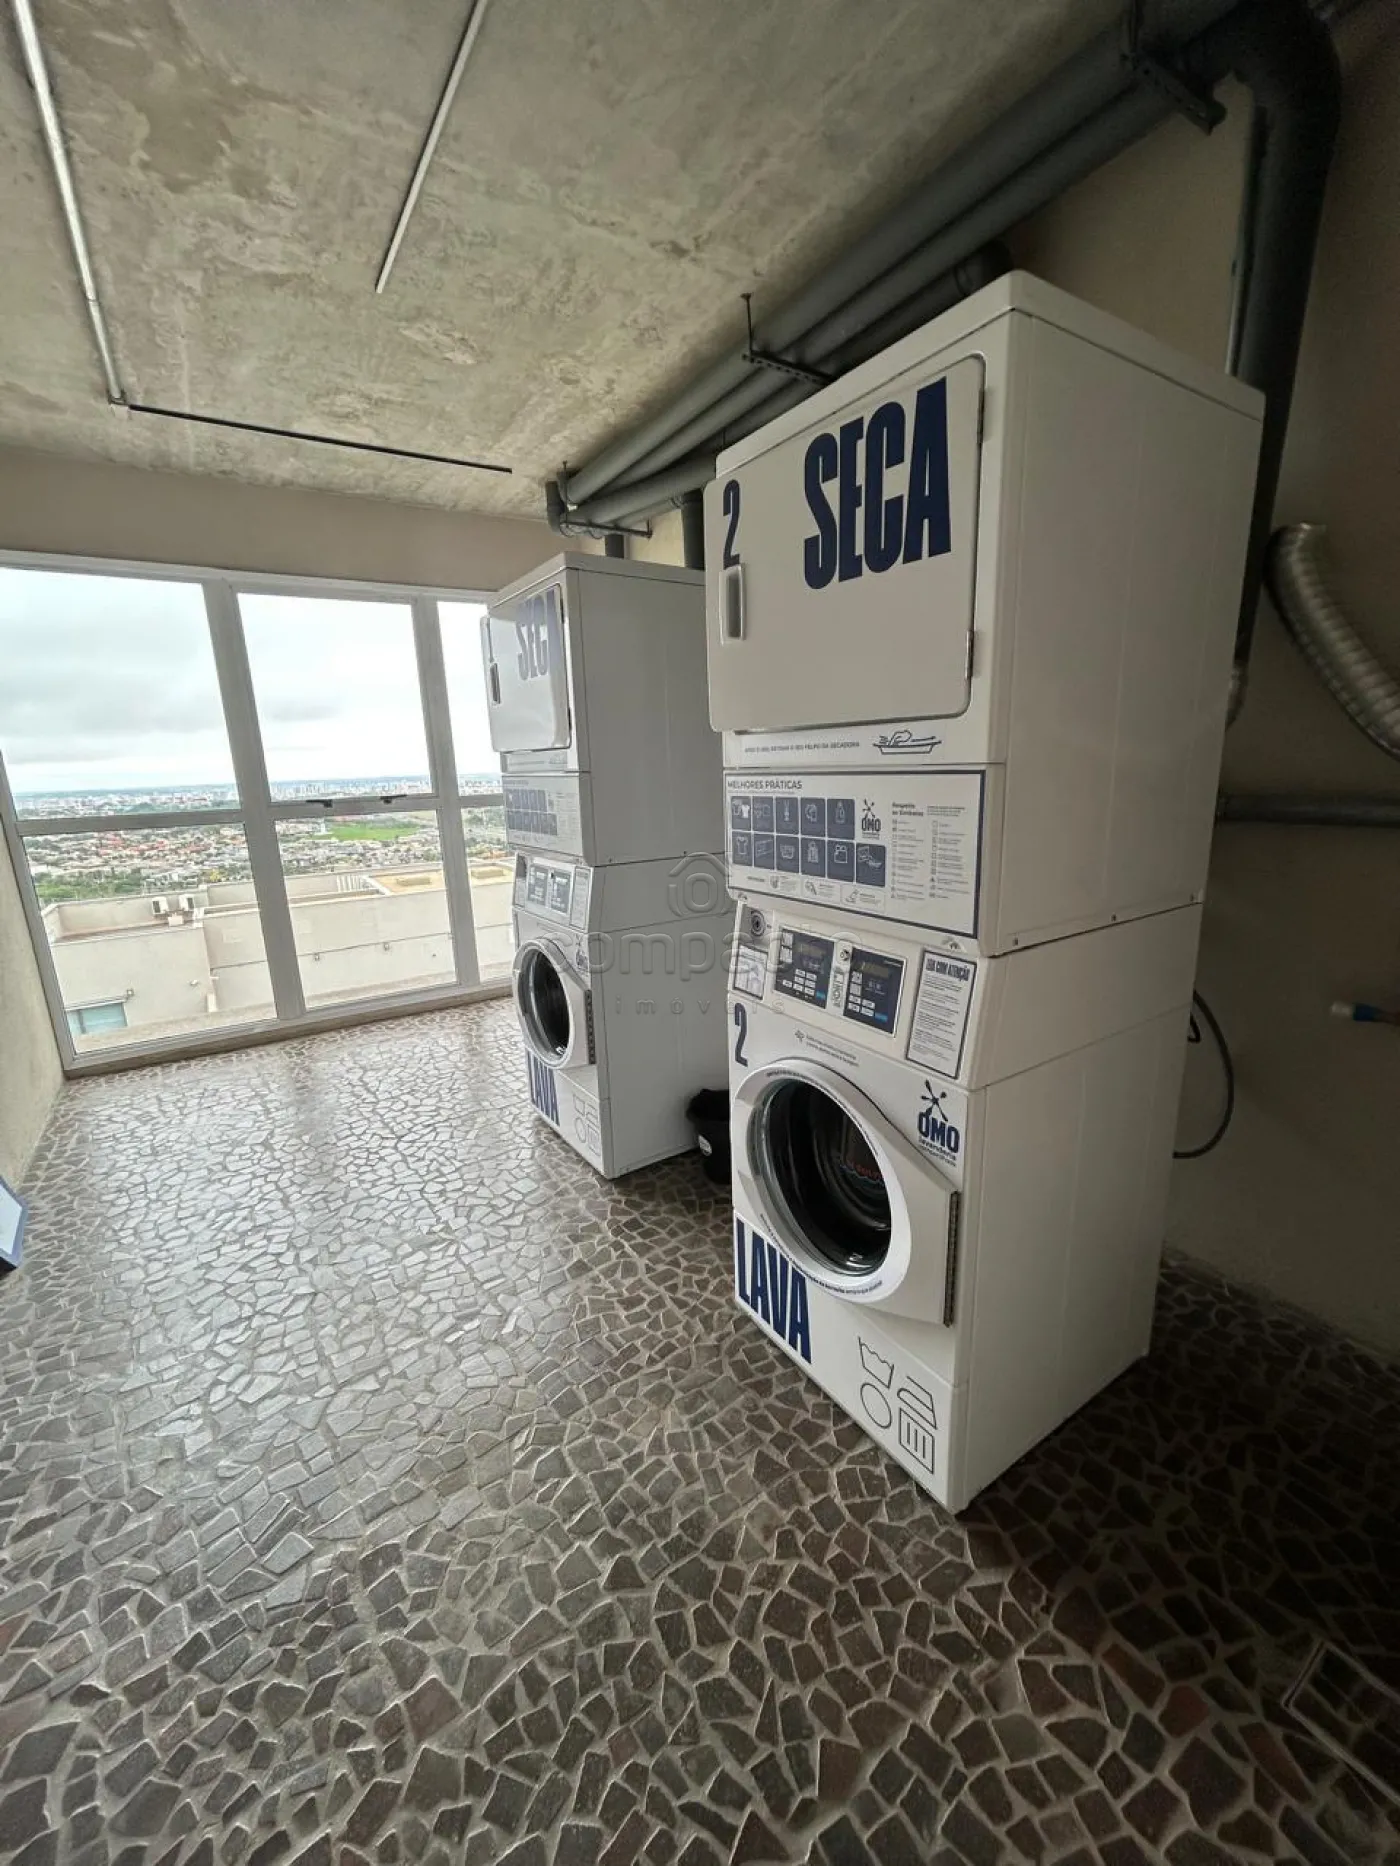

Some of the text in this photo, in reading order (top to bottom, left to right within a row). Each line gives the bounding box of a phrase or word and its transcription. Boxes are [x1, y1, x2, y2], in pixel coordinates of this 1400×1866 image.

[803, 376, 952, 590] SECA
[722, 479, 741, 568] 2
[728, 778, 803, 790] MELHORES PRÁTICAS
[861, 815, 882, 832] OMO
[948, 964, 971, 982] ATENÇÃO
[734, 1002, 748, 1067] 2
[918, 1111, 960, 1154] OMO
[735, 1217, 812, 1364] LAVA
